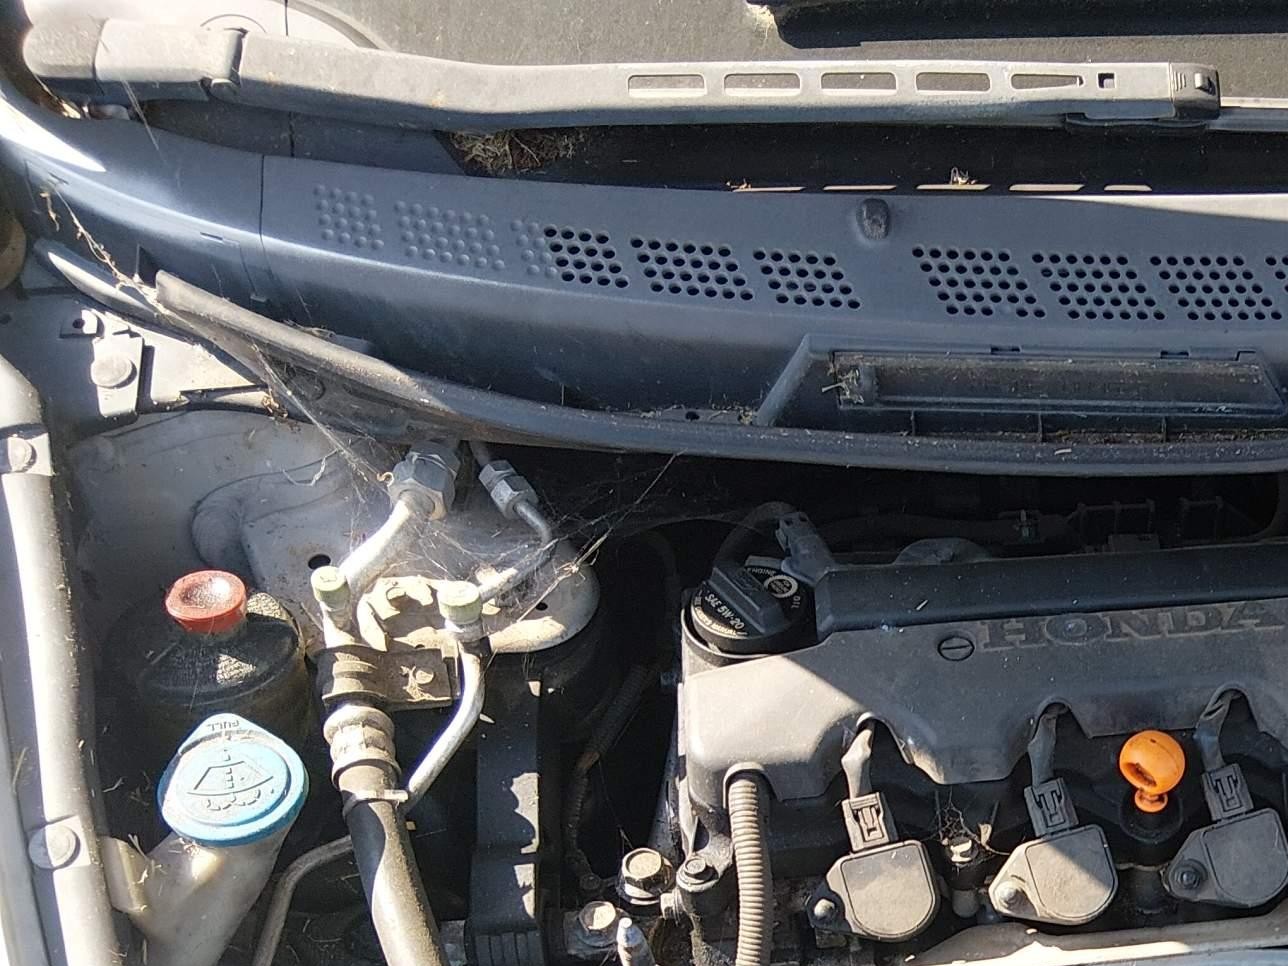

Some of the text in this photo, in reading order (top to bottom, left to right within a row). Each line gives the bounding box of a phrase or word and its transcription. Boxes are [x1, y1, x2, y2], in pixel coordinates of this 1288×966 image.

[704, 593, 722, 608] SAE
[717, 605, 745, 630] 5W-20
[978, 600, 1284, 652] HONDA
[206, 720, 240, 732] PULL
